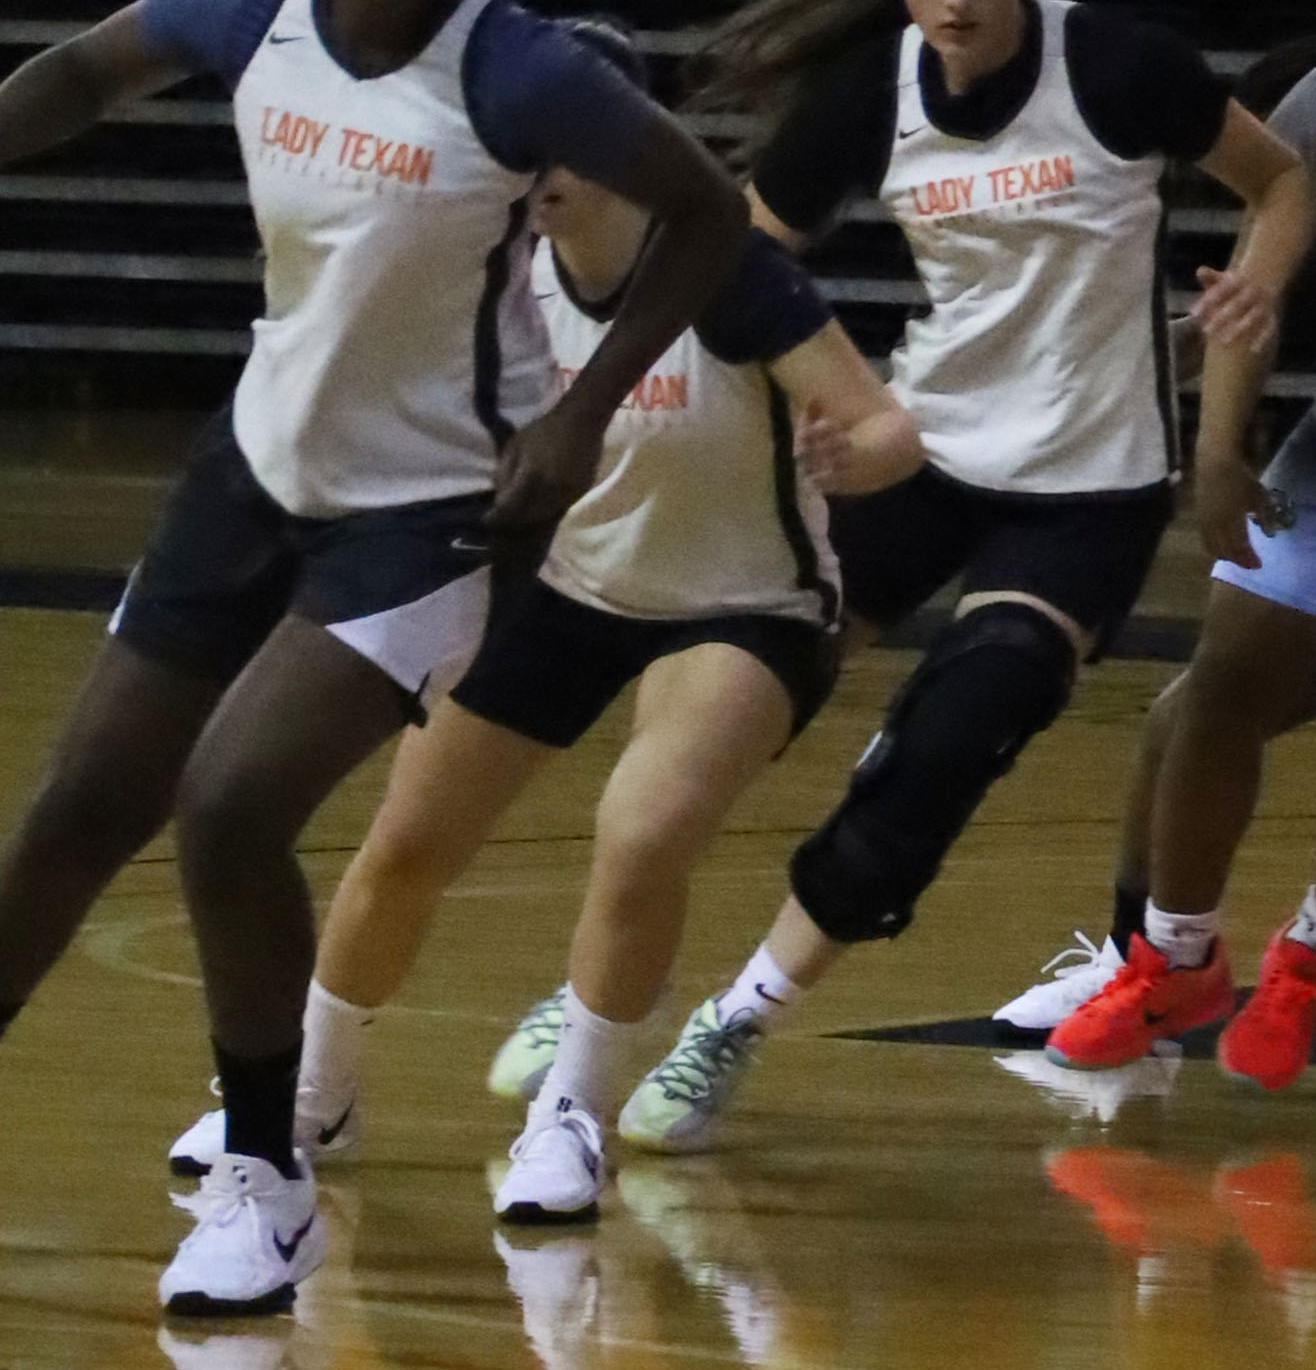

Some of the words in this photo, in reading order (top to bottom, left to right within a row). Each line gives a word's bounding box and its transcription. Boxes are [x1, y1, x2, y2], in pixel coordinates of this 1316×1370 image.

[262, 107, 329, 158] LADY
[339, 128, 435, 186] TEXAN
[910, 175, 974, 215] LADY
[987, 155, 1075, 203] TEXAN
